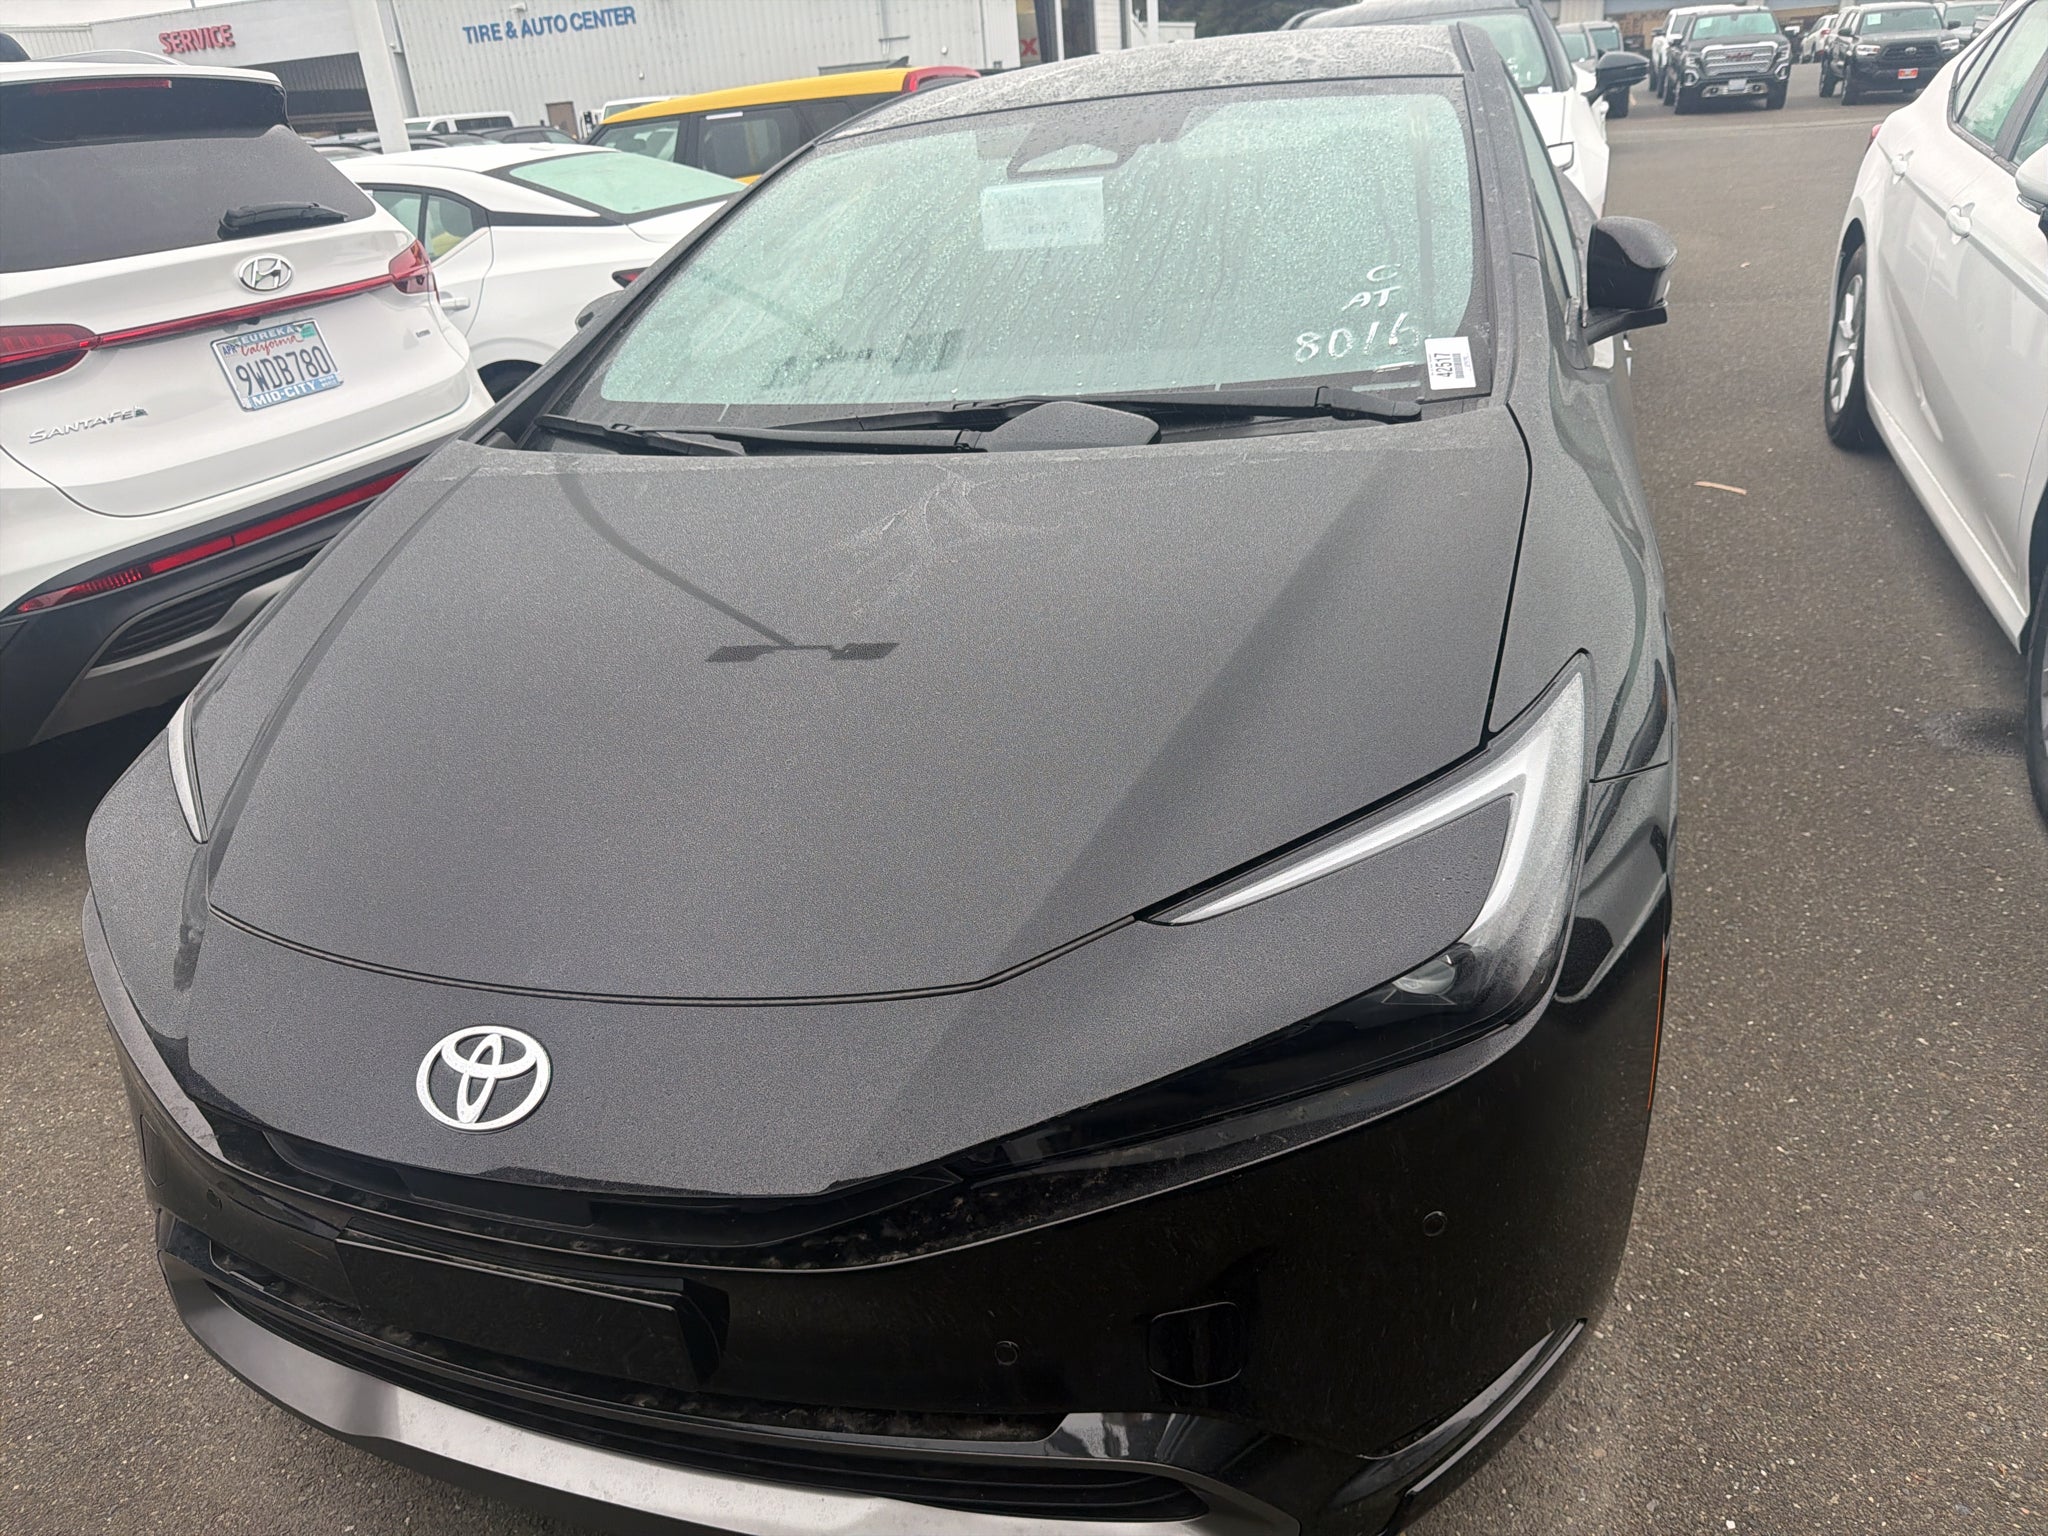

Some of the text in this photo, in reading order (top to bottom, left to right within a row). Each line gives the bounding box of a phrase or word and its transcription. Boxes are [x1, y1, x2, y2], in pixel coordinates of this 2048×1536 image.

[159, 24, 236, 54] SERVICE
[462, 6, 637, 45] TIRE & AUTO CENTER
[1341, 285, 1403, 312] AT
[240, 325, 297, 344] EUREKA
[240, 334, 305, 357] California
[1295, 312, 1421, 364] 8016
[235, 345, 332, 396] 9WDB780
[1433, 352, 1454, 378] 42517
